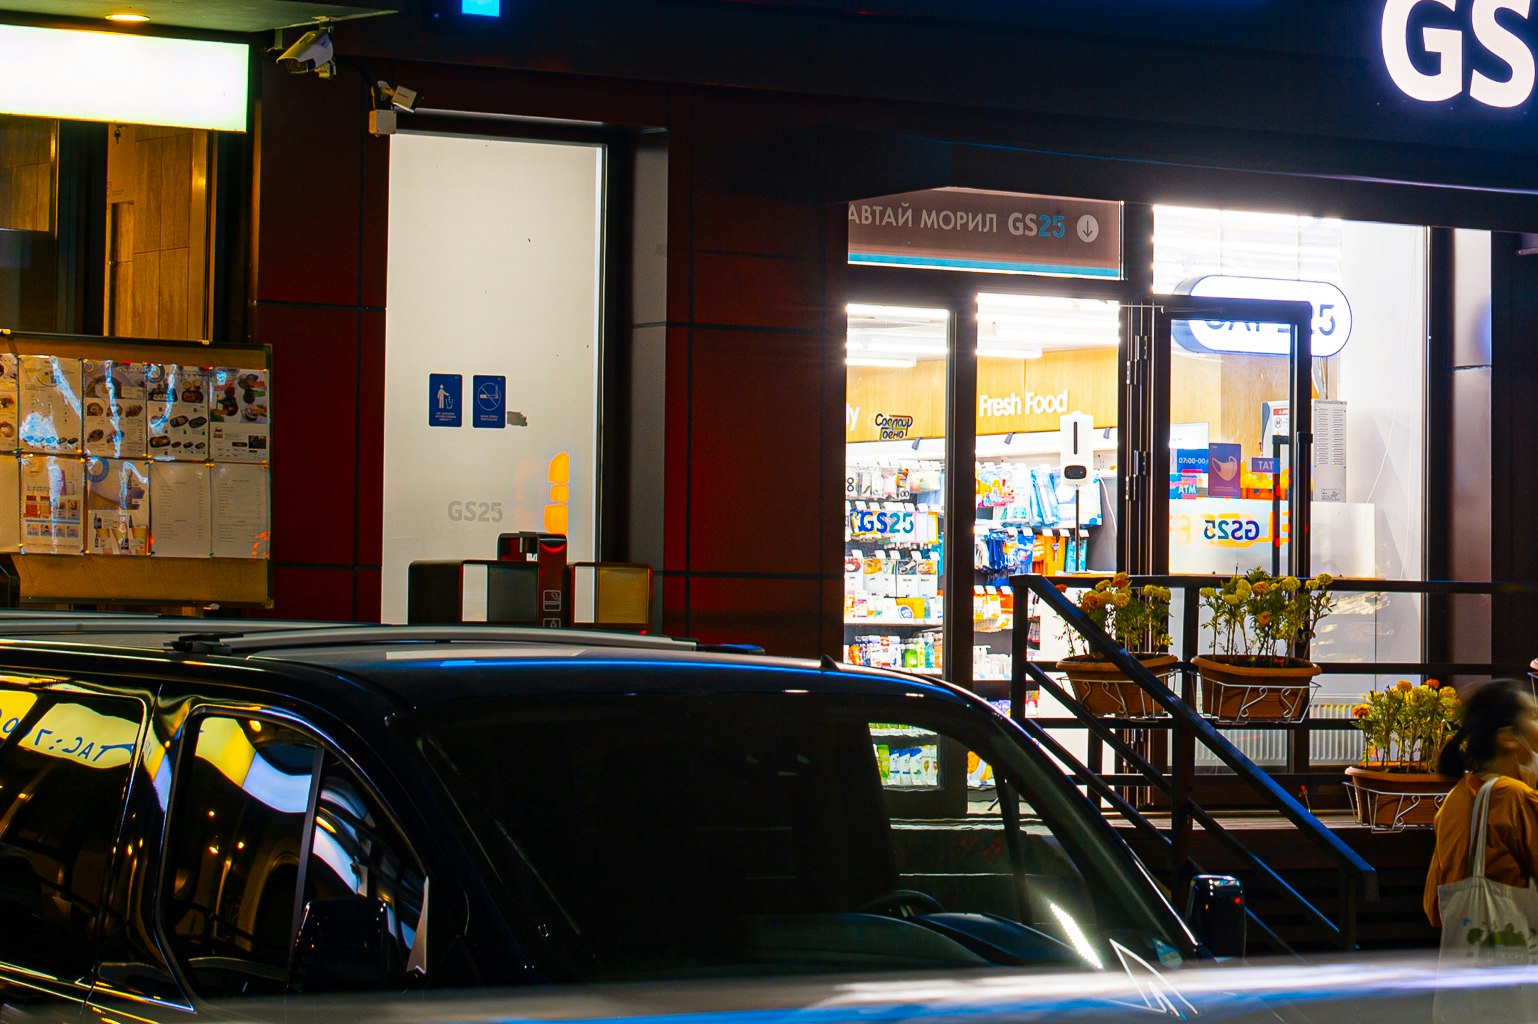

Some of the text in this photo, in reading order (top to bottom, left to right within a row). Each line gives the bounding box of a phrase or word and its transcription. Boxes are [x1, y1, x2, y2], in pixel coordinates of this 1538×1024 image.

[920, 209, 997, 233] МОРИЛ
[1008, 212, 1066, 238] GS25
[979, 389, 1068, 417] Fresh Food
[1178, 484, 1197, 494] ATM
[448, 501, 503, 523] GS25
[859, 511, 915, 534] GS25
